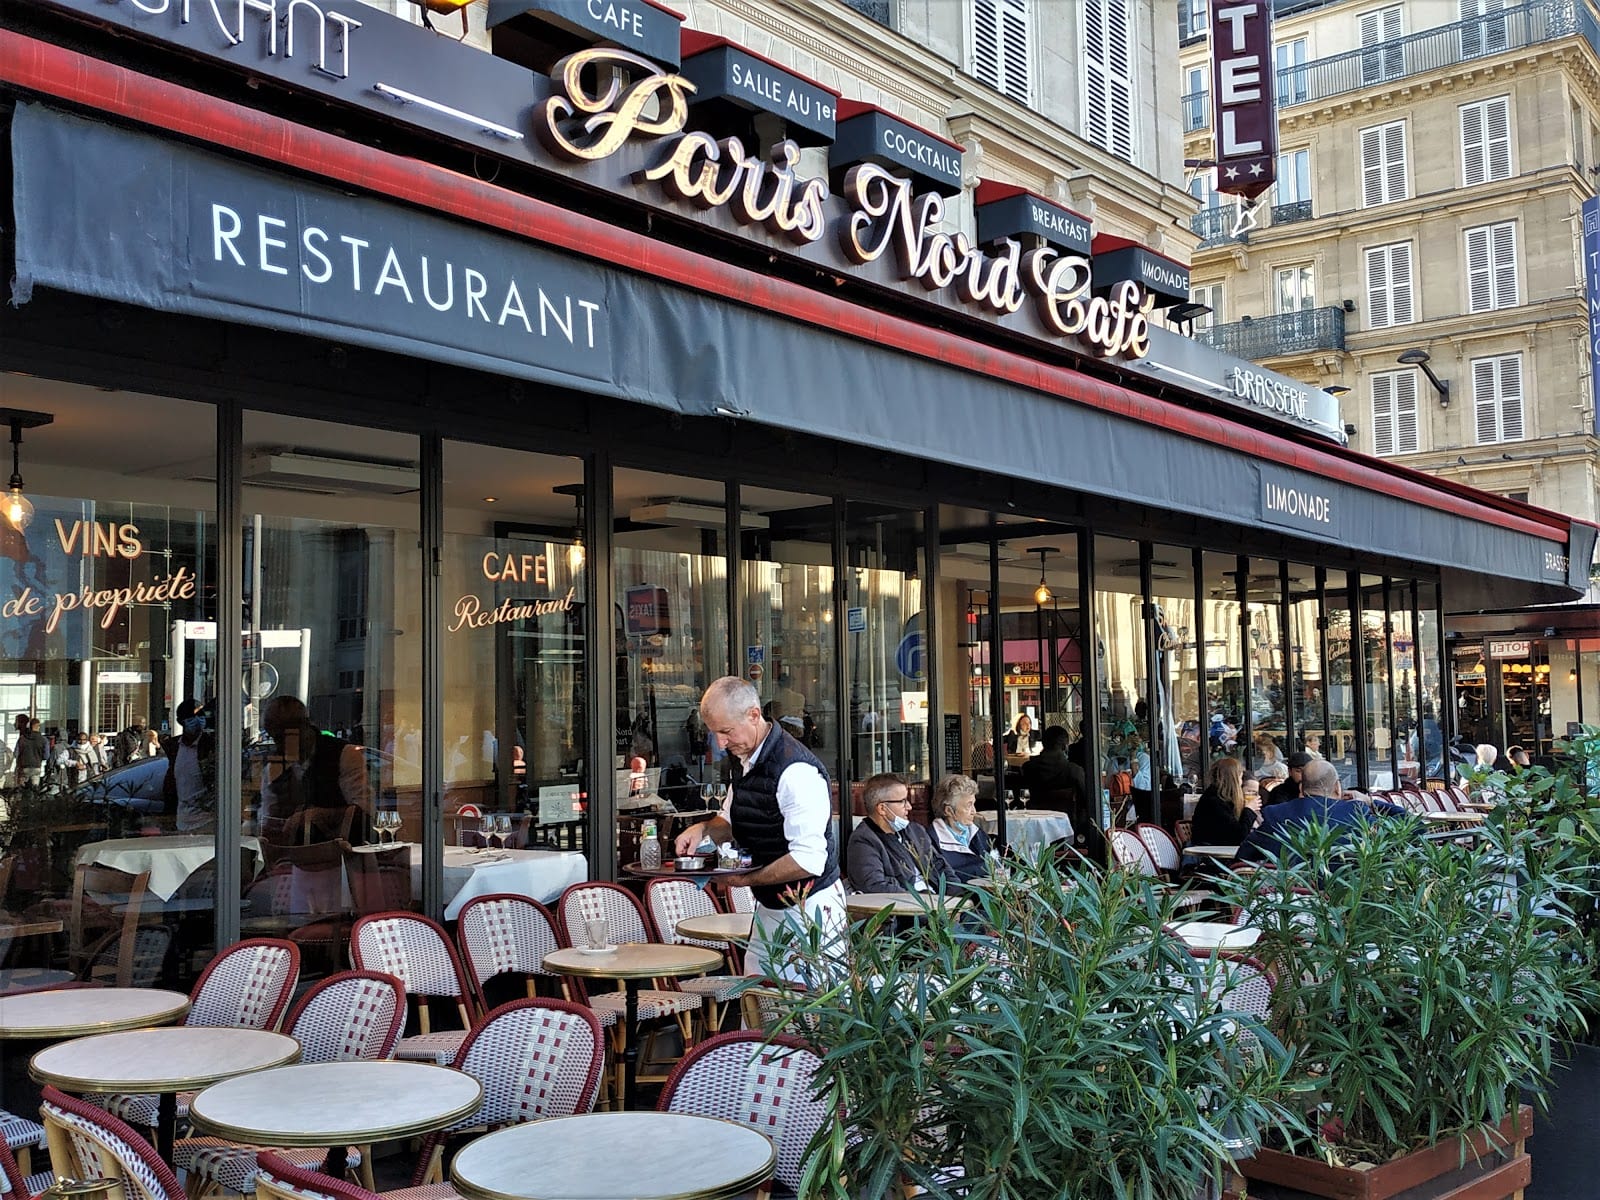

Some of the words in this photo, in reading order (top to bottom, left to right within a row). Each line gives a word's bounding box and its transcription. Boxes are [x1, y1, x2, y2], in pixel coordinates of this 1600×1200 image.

[587, 0, 643, 38] CAFE
[732, 63, 782, 103] SALLE
[786, 89, 811, 115] AU
[1217, 0, 1262, 156] TEL
[883, 129, 962, 177] COCKTAILS
[545, 47, 828, 245] Paris
[850, 162, 1025, 313] Nord
[1031, 248, 1155, 358] Café
[1032, 204, 1088, 243] BREAKFAST
[211, 203, 601, 349] RESTAURANT
[1141, 260, 1189, 291] LIMONADE
[1234, 366, 1309, 420] BRASSERIE
[1266, 482, 1330, 523] LIMONADE
[54, 518, 143, 560] VINS
[2, 587, 43, 619] de
[45, 566, 197, 634] propriété
[447, 586, 575, 633] Restaurant
